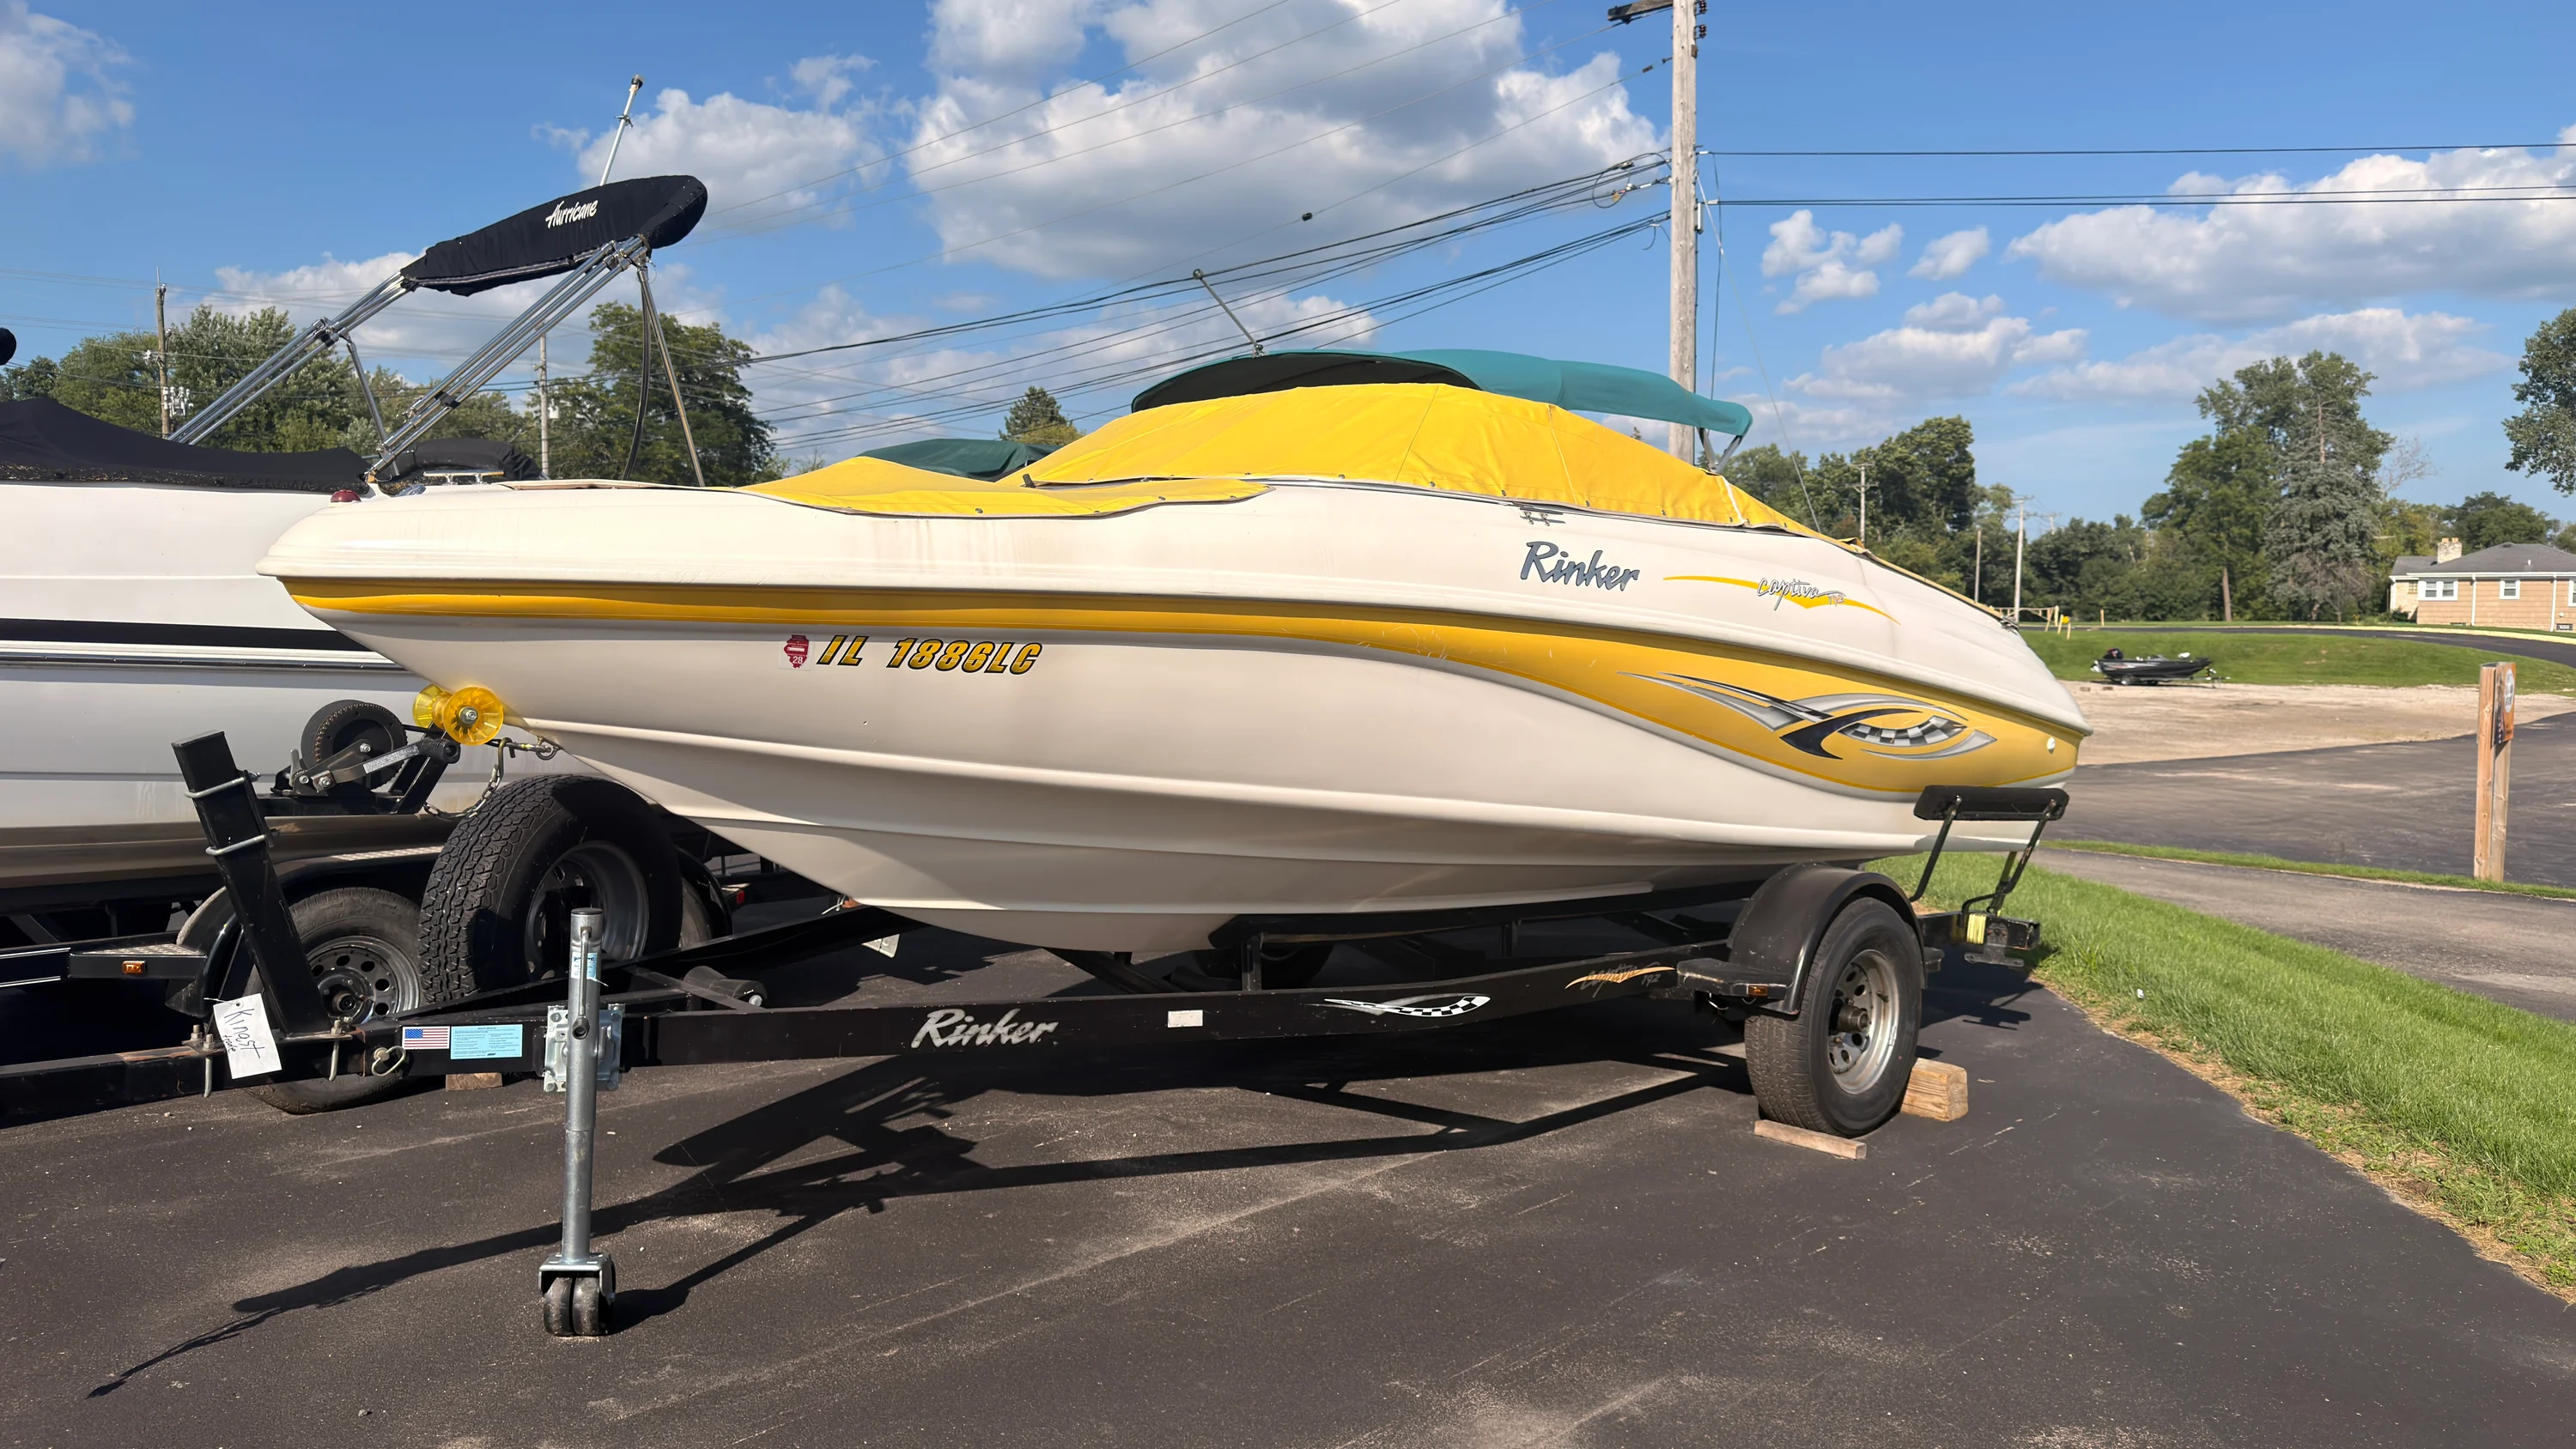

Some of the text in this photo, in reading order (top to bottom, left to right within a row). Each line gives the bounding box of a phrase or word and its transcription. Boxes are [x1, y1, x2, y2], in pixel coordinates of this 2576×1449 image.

[545, 200, 598, 229] Hurricane
[1520, 541, 1640, 591] Rinker
[793, 656, 803, 664] 28
[816, 634, 870, 666] IL
[885, 637, 1043, 676] 1886LC
[910, 1008, 1060, 1049] Rinker
